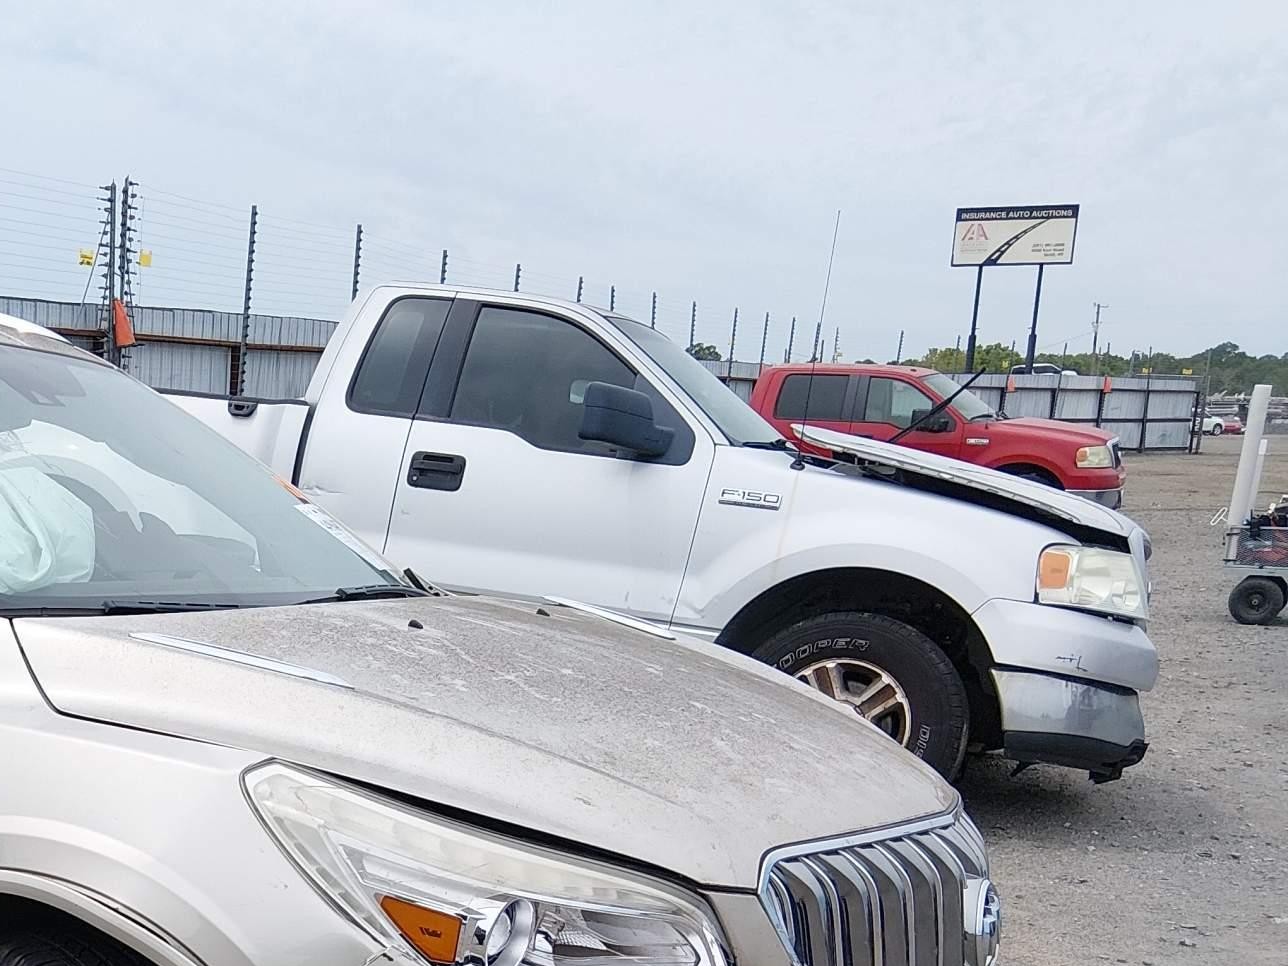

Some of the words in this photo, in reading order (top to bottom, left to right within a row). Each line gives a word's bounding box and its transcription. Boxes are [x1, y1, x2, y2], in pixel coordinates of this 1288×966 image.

[961, 211, 1007, 219] INSURANCE
[1008, 210, 1030, 218] AUTO
[1032, 209, 1073, 217] AUCTIONS
[721, 488, 780, 504] F-150
[771, 638, 870, 669] OOPER
